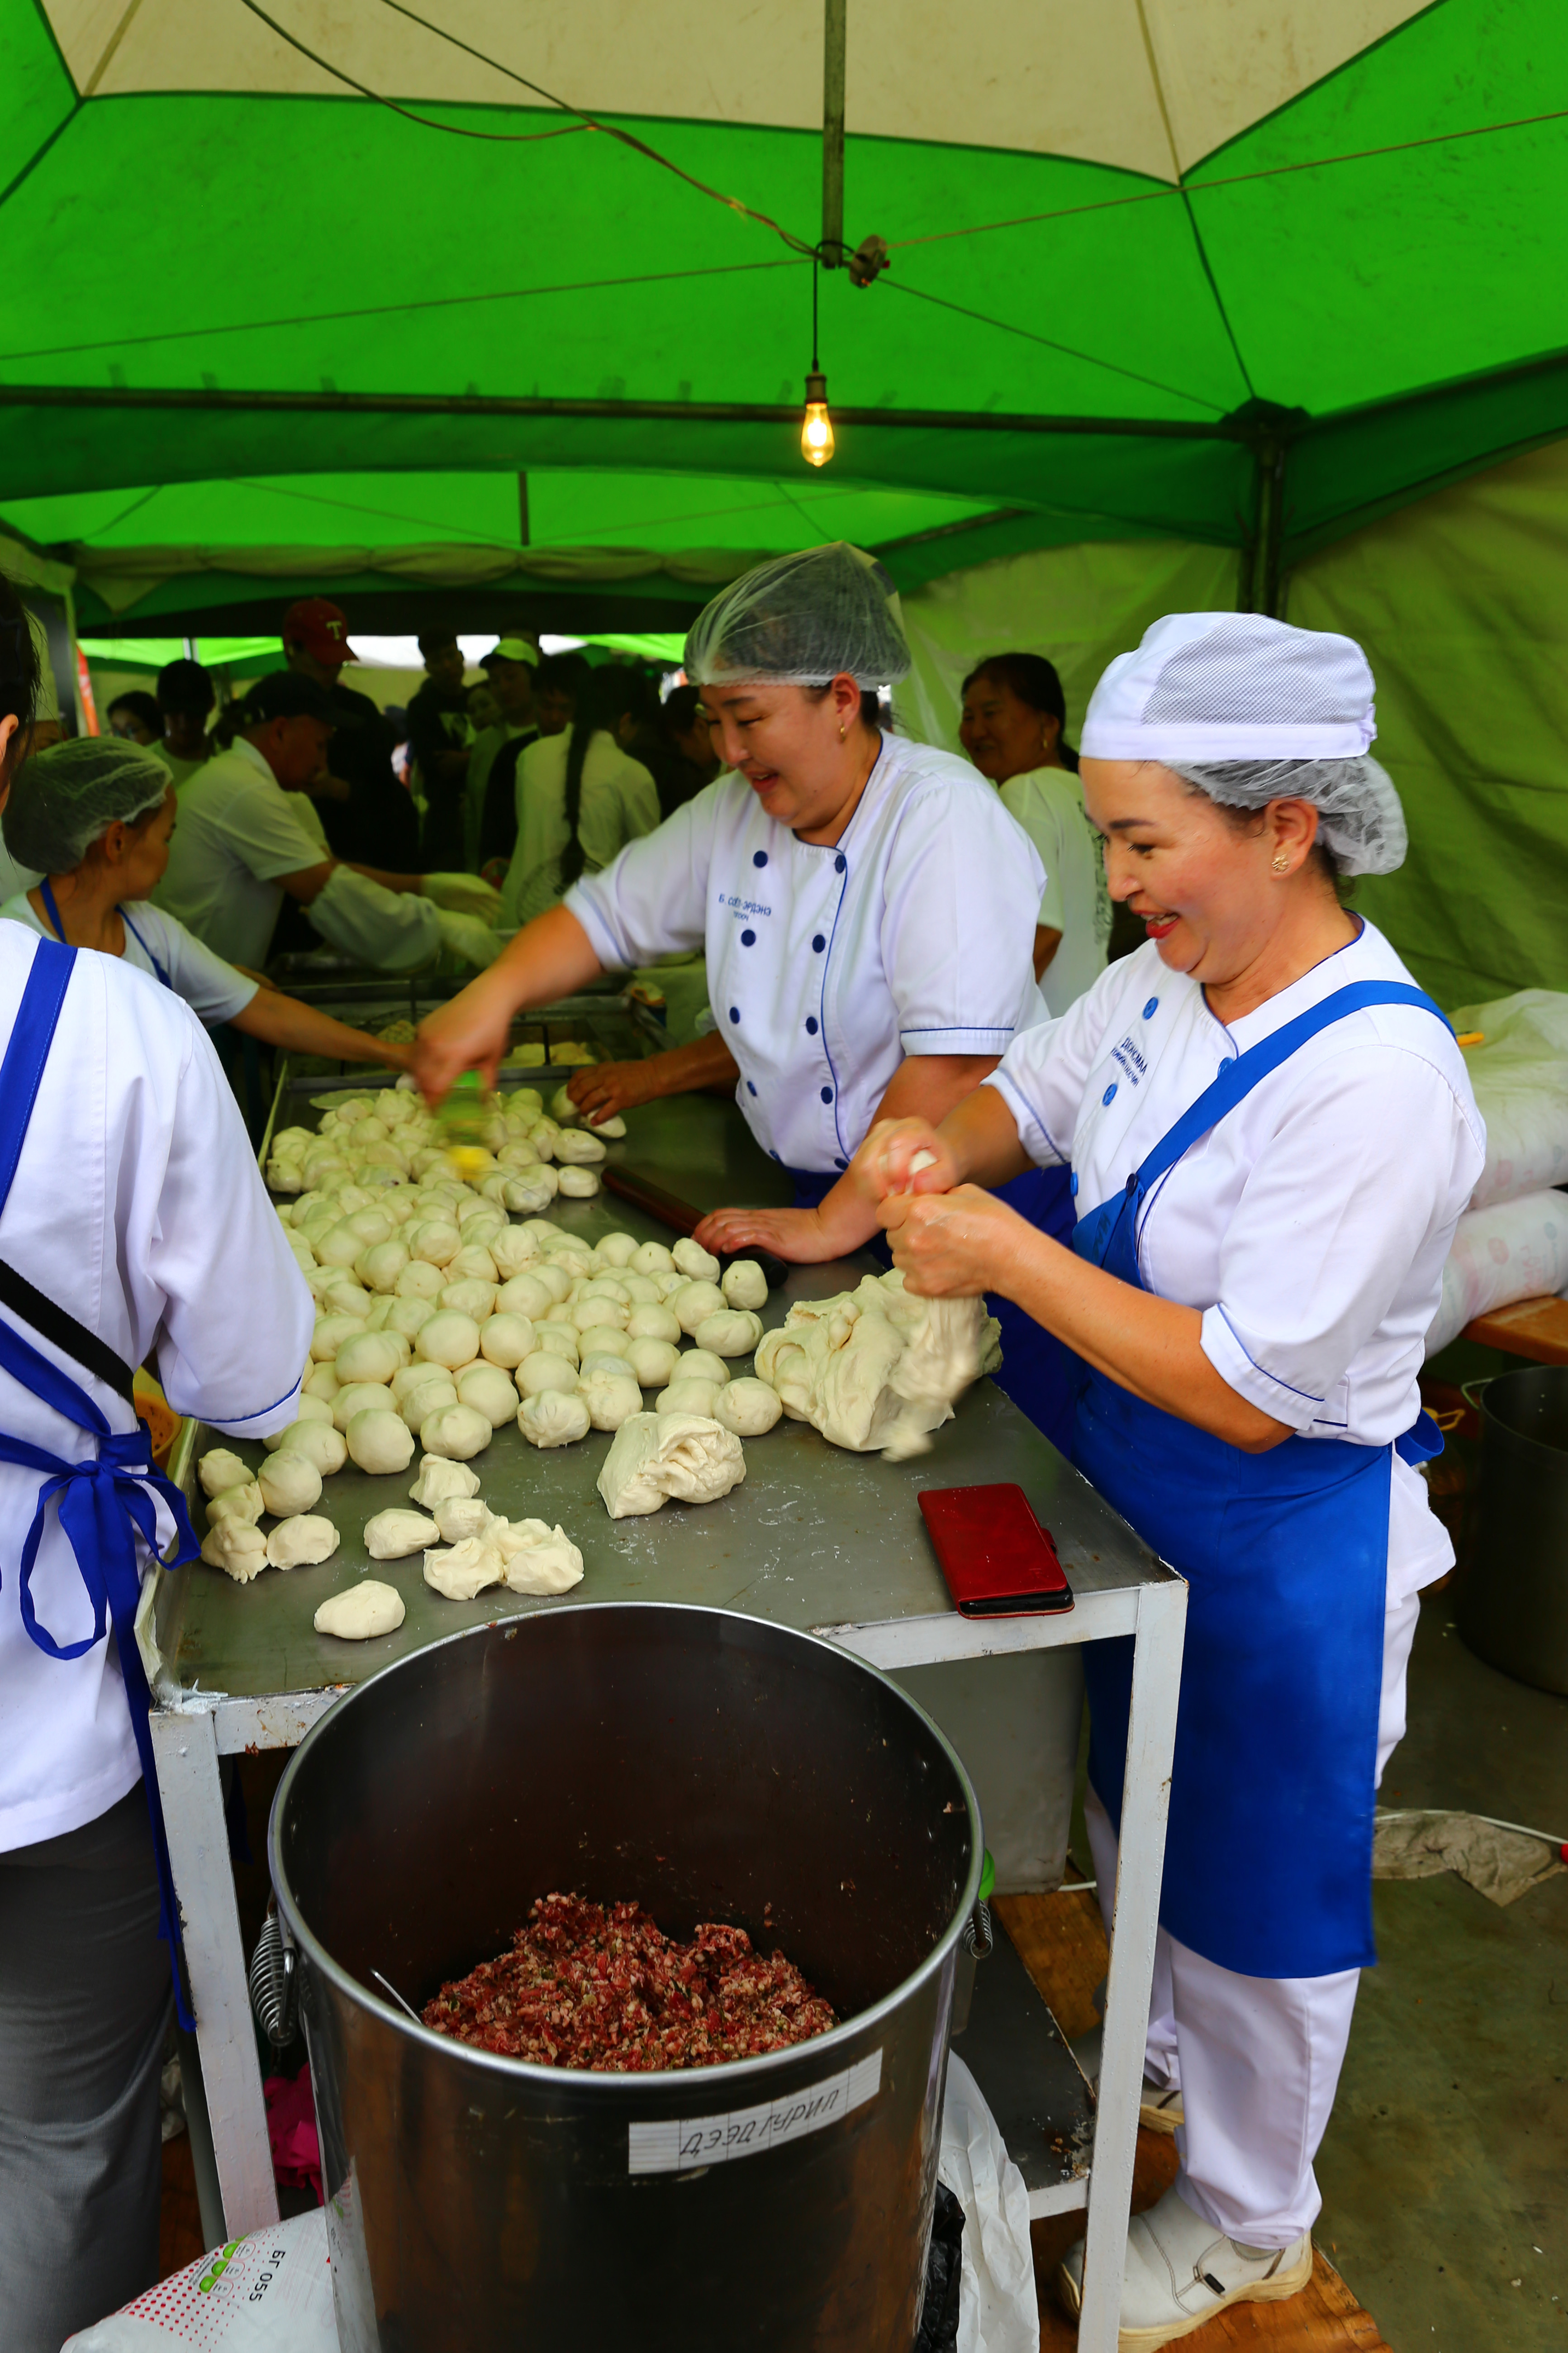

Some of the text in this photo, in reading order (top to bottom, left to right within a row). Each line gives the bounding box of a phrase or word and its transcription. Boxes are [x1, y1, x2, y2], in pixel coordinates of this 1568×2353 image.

[326, 620, 342, 640] T
[679, 2089, 840, 2158] ДЭЭД ГУРИЛ
[248, 2248, 286, 2302] БГ 055
